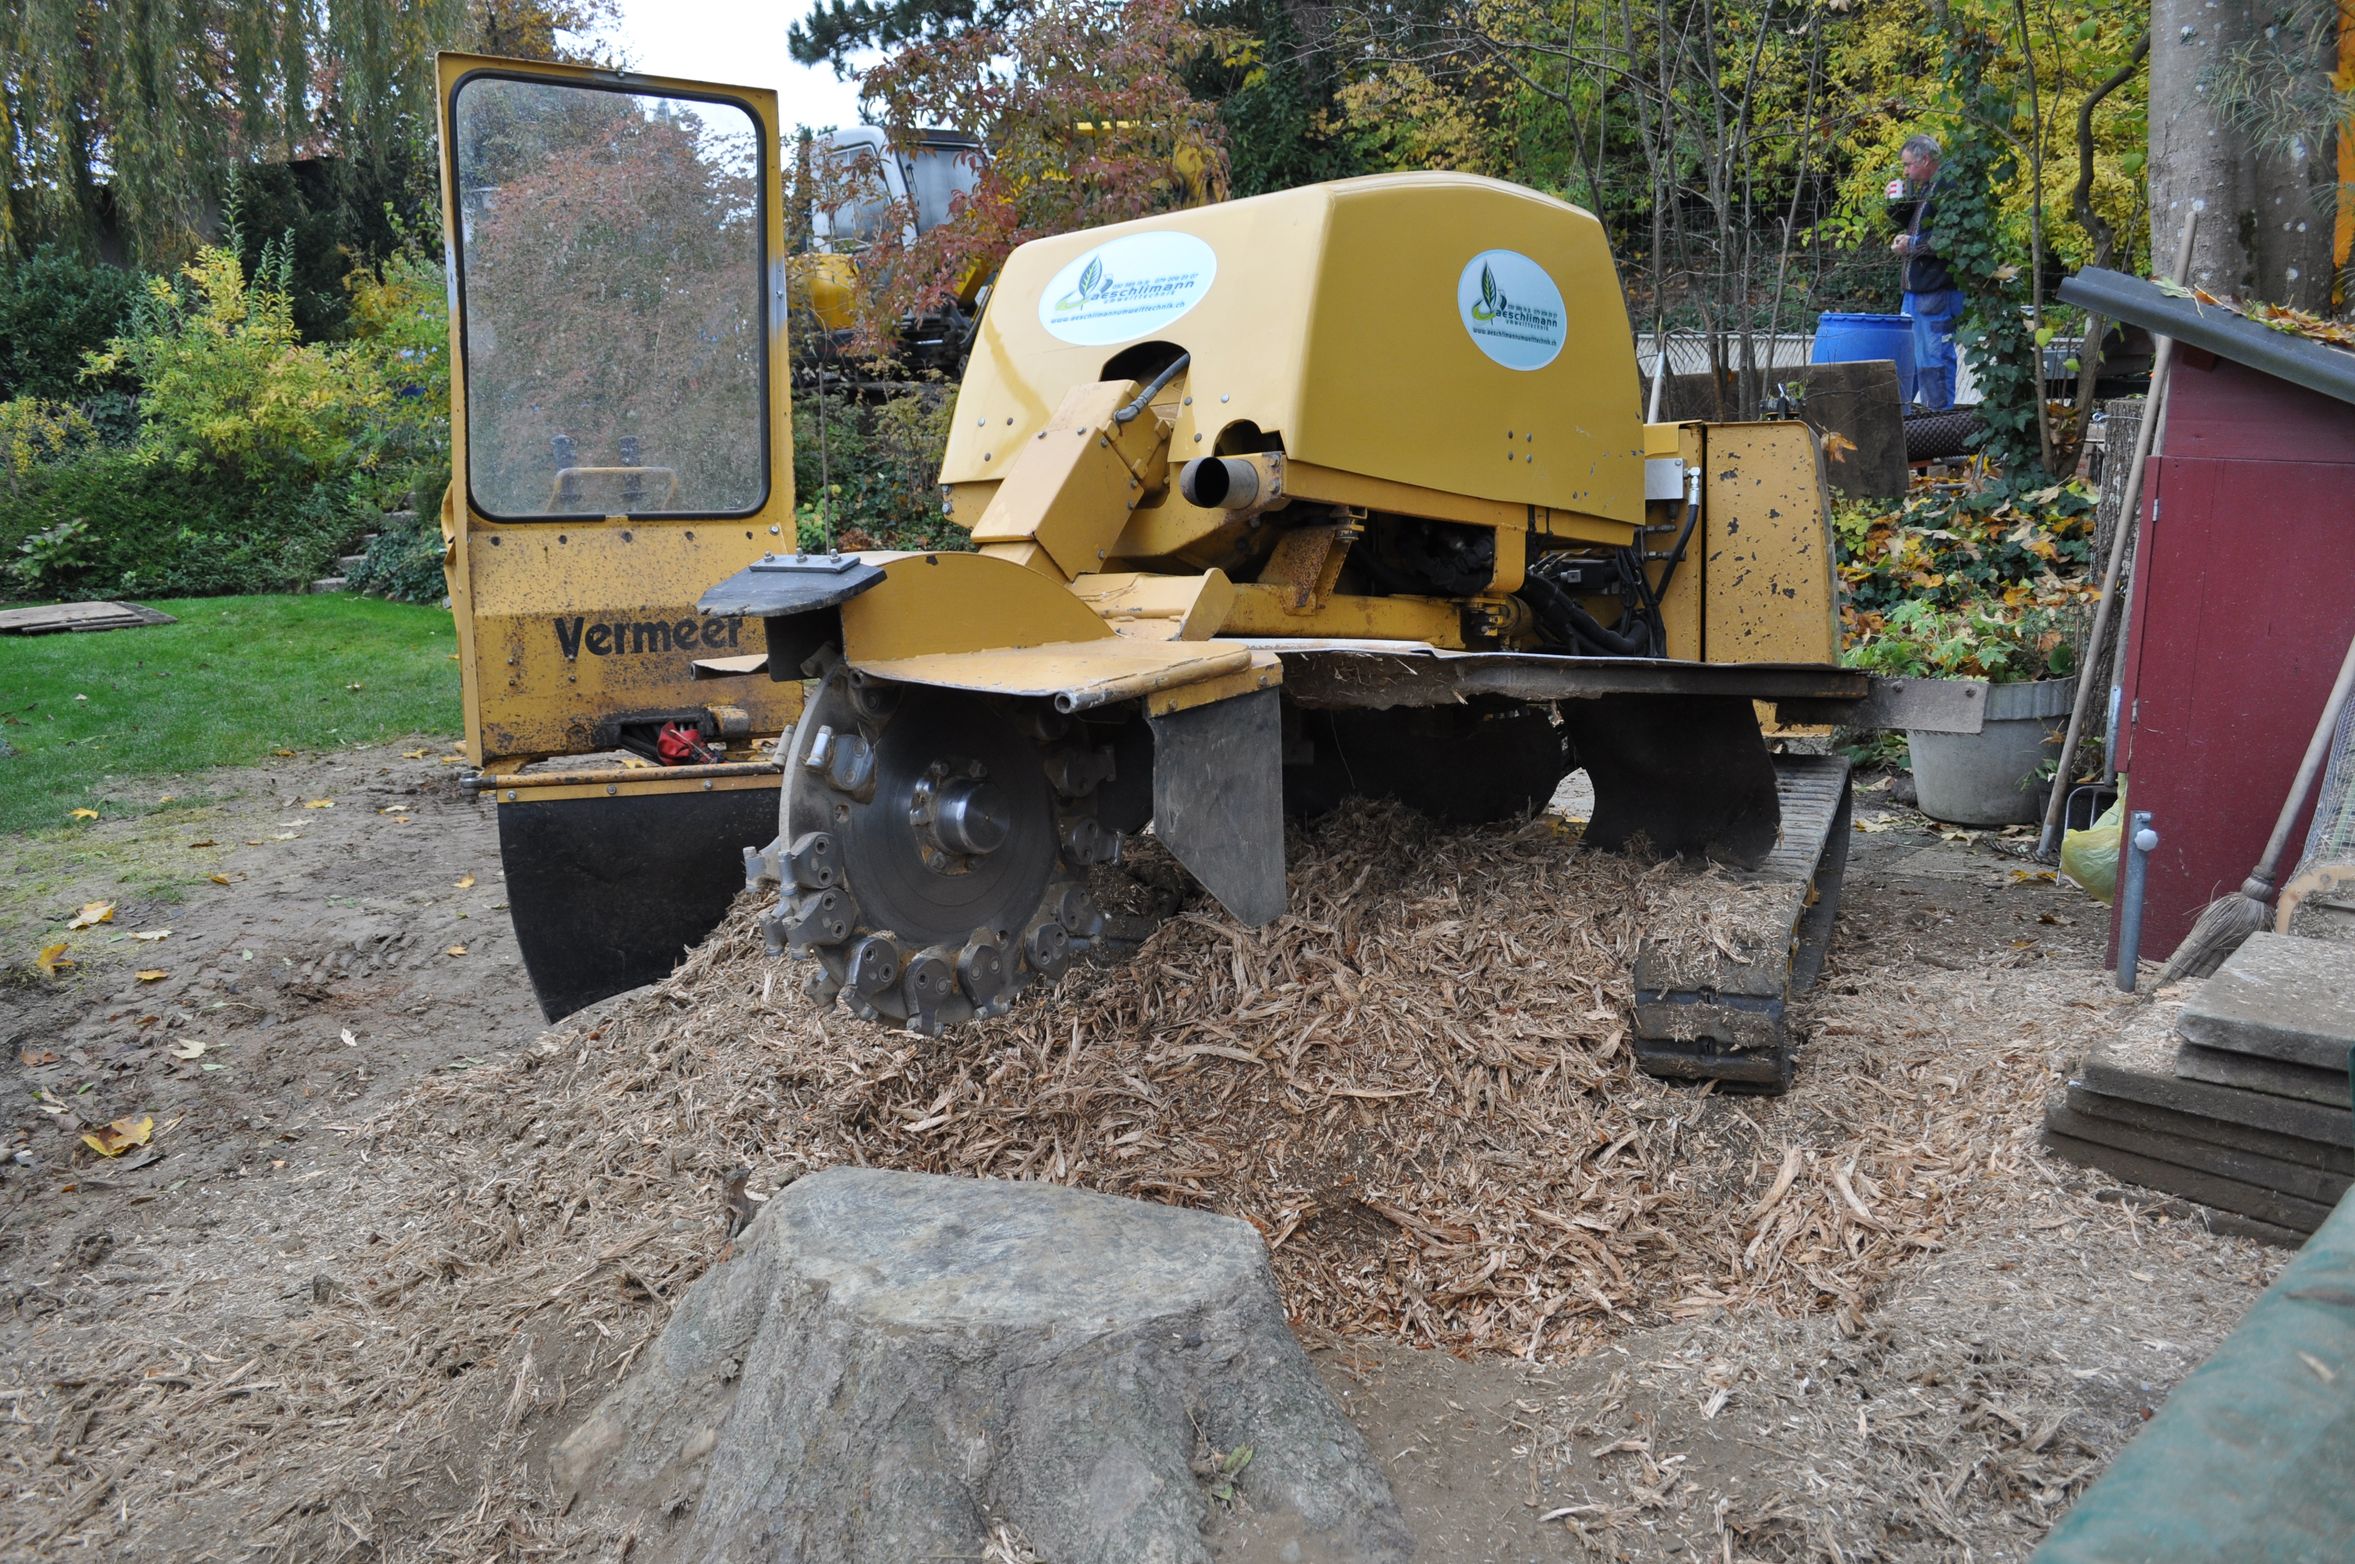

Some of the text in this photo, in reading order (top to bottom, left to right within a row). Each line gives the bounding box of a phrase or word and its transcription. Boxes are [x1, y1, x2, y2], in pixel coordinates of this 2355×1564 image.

[1091, 280, 1195, 301] aeschlimann
[1495, 309, 1558, 328] aeschlimann
[553, 616, 744, 658] Vermeer
